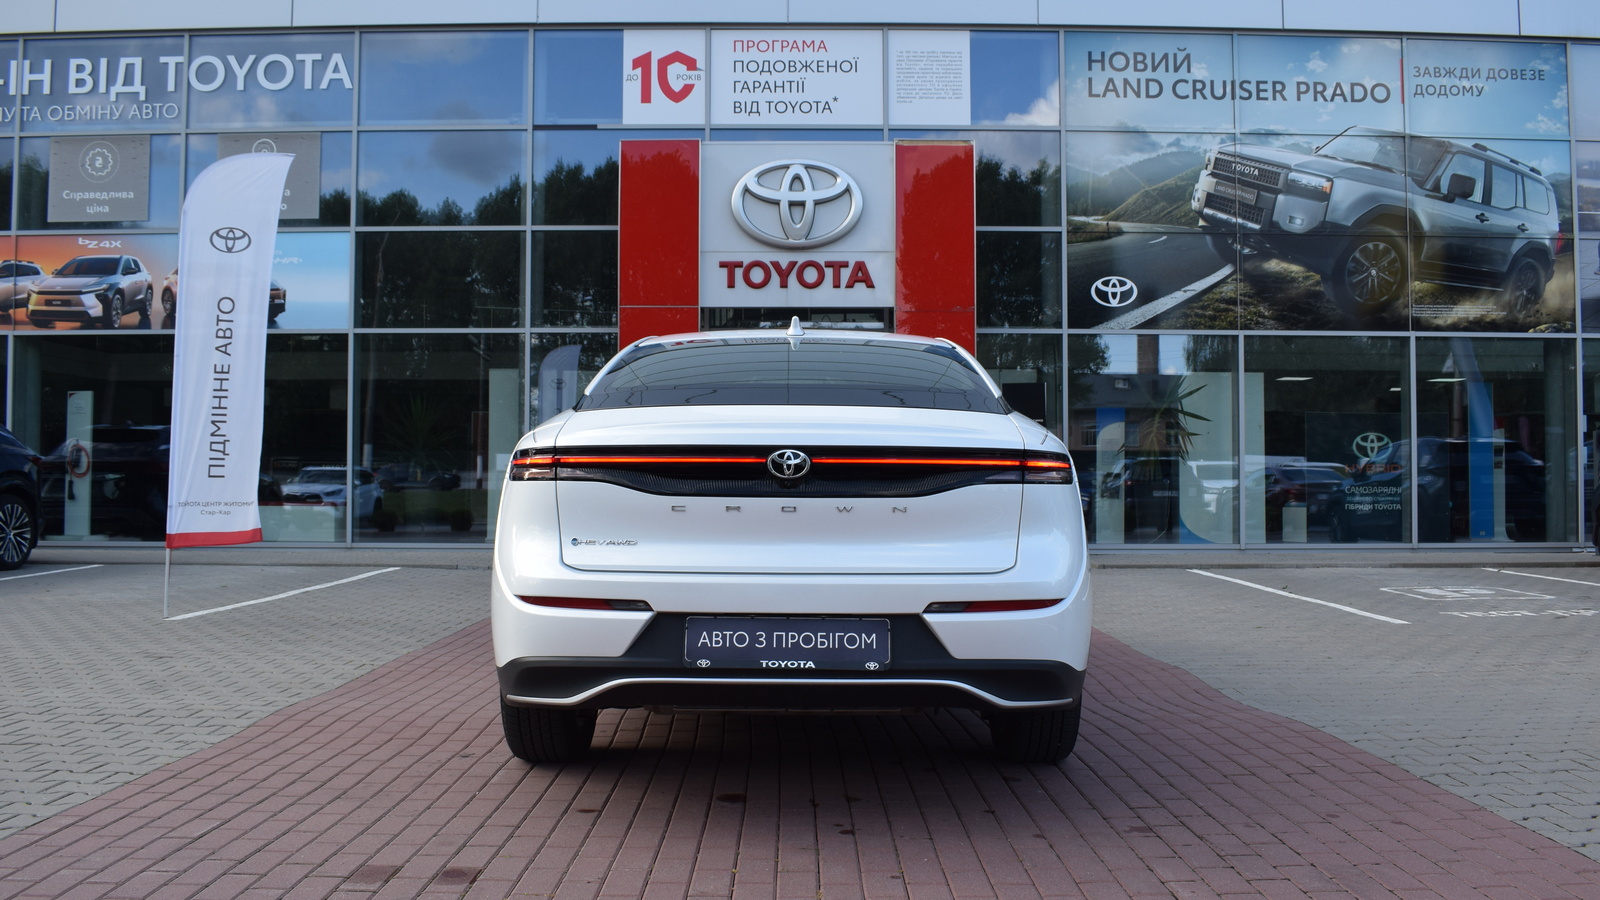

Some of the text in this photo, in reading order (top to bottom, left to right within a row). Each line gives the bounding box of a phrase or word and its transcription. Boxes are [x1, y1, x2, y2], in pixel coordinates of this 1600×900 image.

[733, 39, 828, 53] ПРОГРАМА
[733, 56, 860, 76] ПОДОВЖЕНОЇ
[1087, 47, 1192, 74] НОВИЙ
[68, 56, 147, 102] ВІД
[159, 53, 354, 93] TOYOTA
[625, 73, 639, 82] ДО
[676, 73, 702, 81] РОКІВ
[1413, 65, 1546, 82] ЗАВЖДИ ДОВЕЗЕ
[733, 77, 807, 94] ГАРАНТІЇ
[1087, 77, 1392, 104] LAND CRUISER PRADO
[1413, 84, 1485, 98] ДОДОМУ
[22, 106, 42, 122] ТА
[47, 104, 124, 121] ОБМІНУ
[128, 102, 179, 119] АВТО
[733, 100, 761, 117] ВІД
[1231, 163, 1259, 176] TOYOTA
[63, 190, 134, 201] Справедлива
[86, 203, 110, 214] ціна
[78, 237, 122, 249] bZ4X
[719, 260, 876, 289] TOYOTA
[208, 296, 236, 479] ПІДМІННЕ АВТО
[1344, 486, 1402, 495] САМОЗАРЯДНІ
[671, 504, 908, 513] CROWN
[697, 631, 750, 648] АВТО
[773, 632, 877, 650] ПРОБІГОМ
[760, 660, 816, 669] TOYOTA
